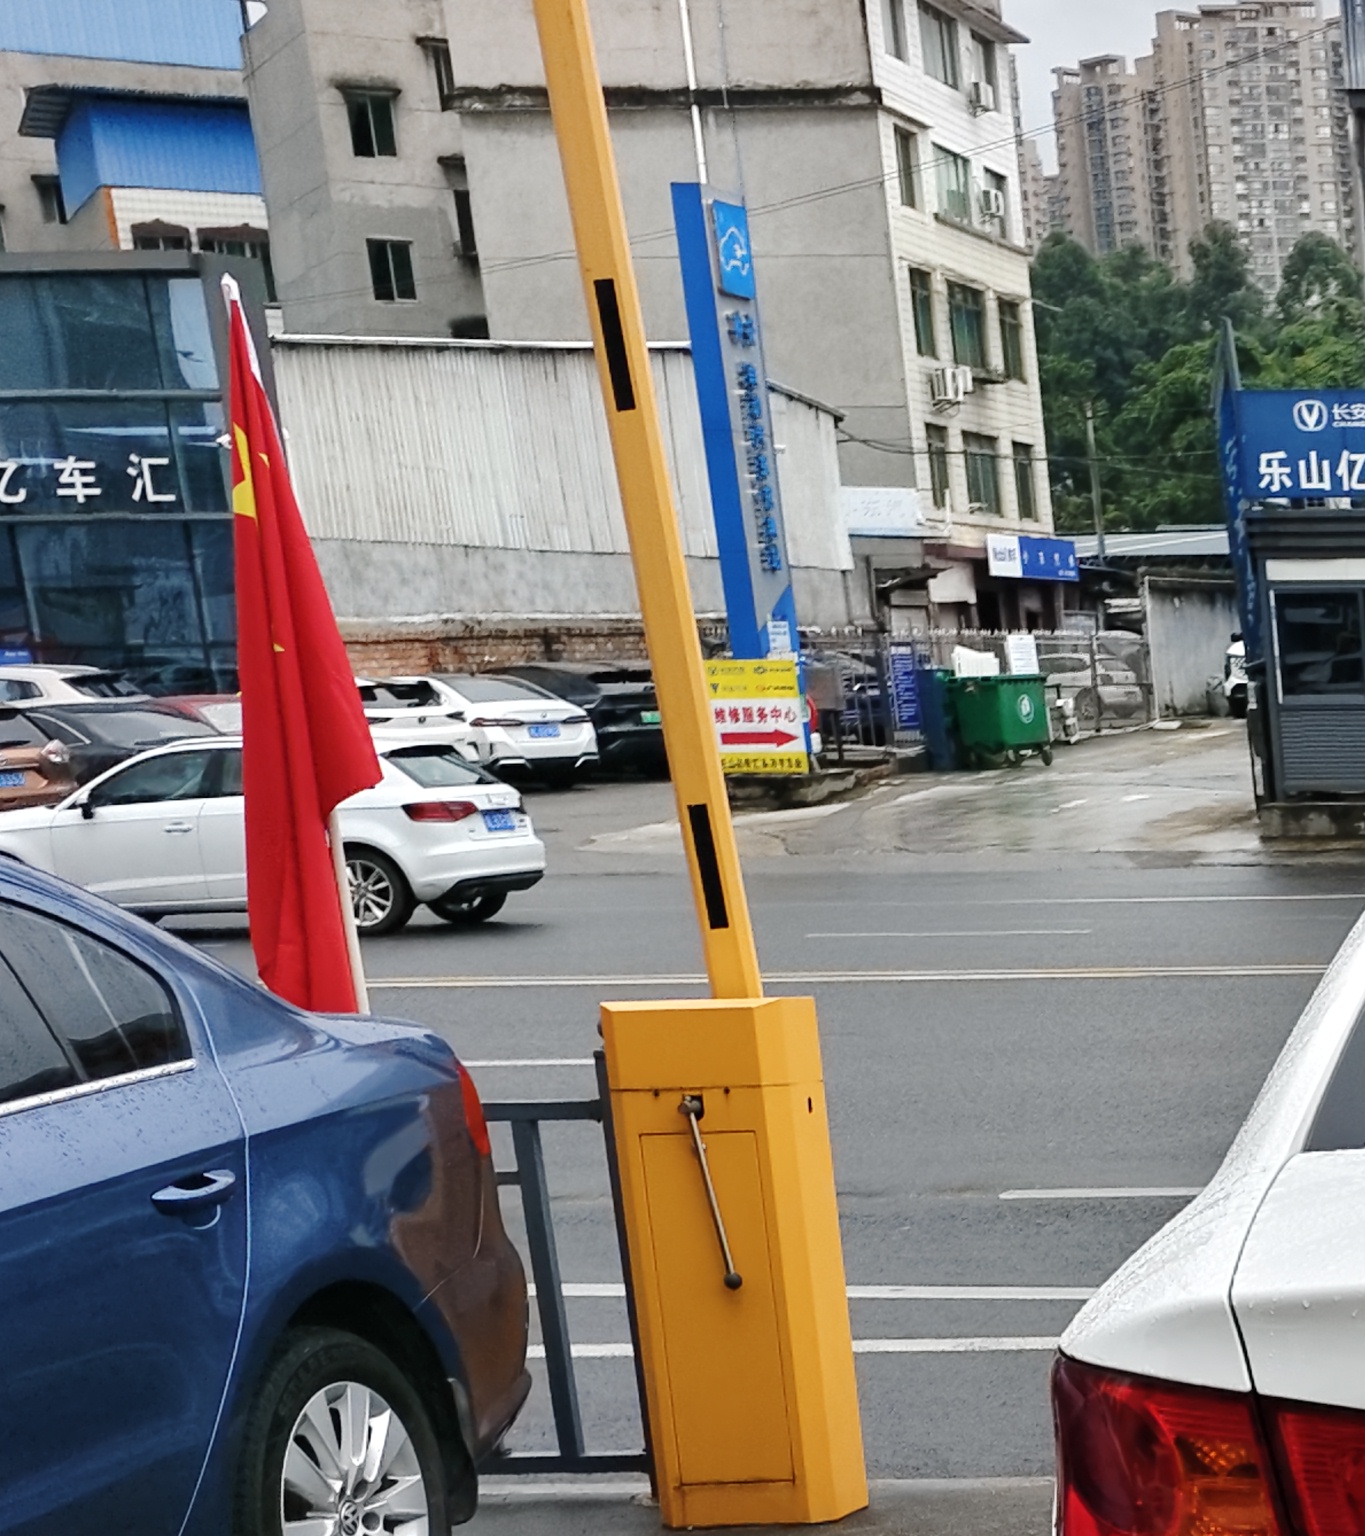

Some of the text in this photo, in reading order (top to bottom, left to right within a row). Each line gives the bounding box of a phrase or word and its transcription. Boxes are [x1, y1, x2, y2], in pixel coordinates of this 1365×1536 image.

[714, 706, 797, 724] 维修服务中心
